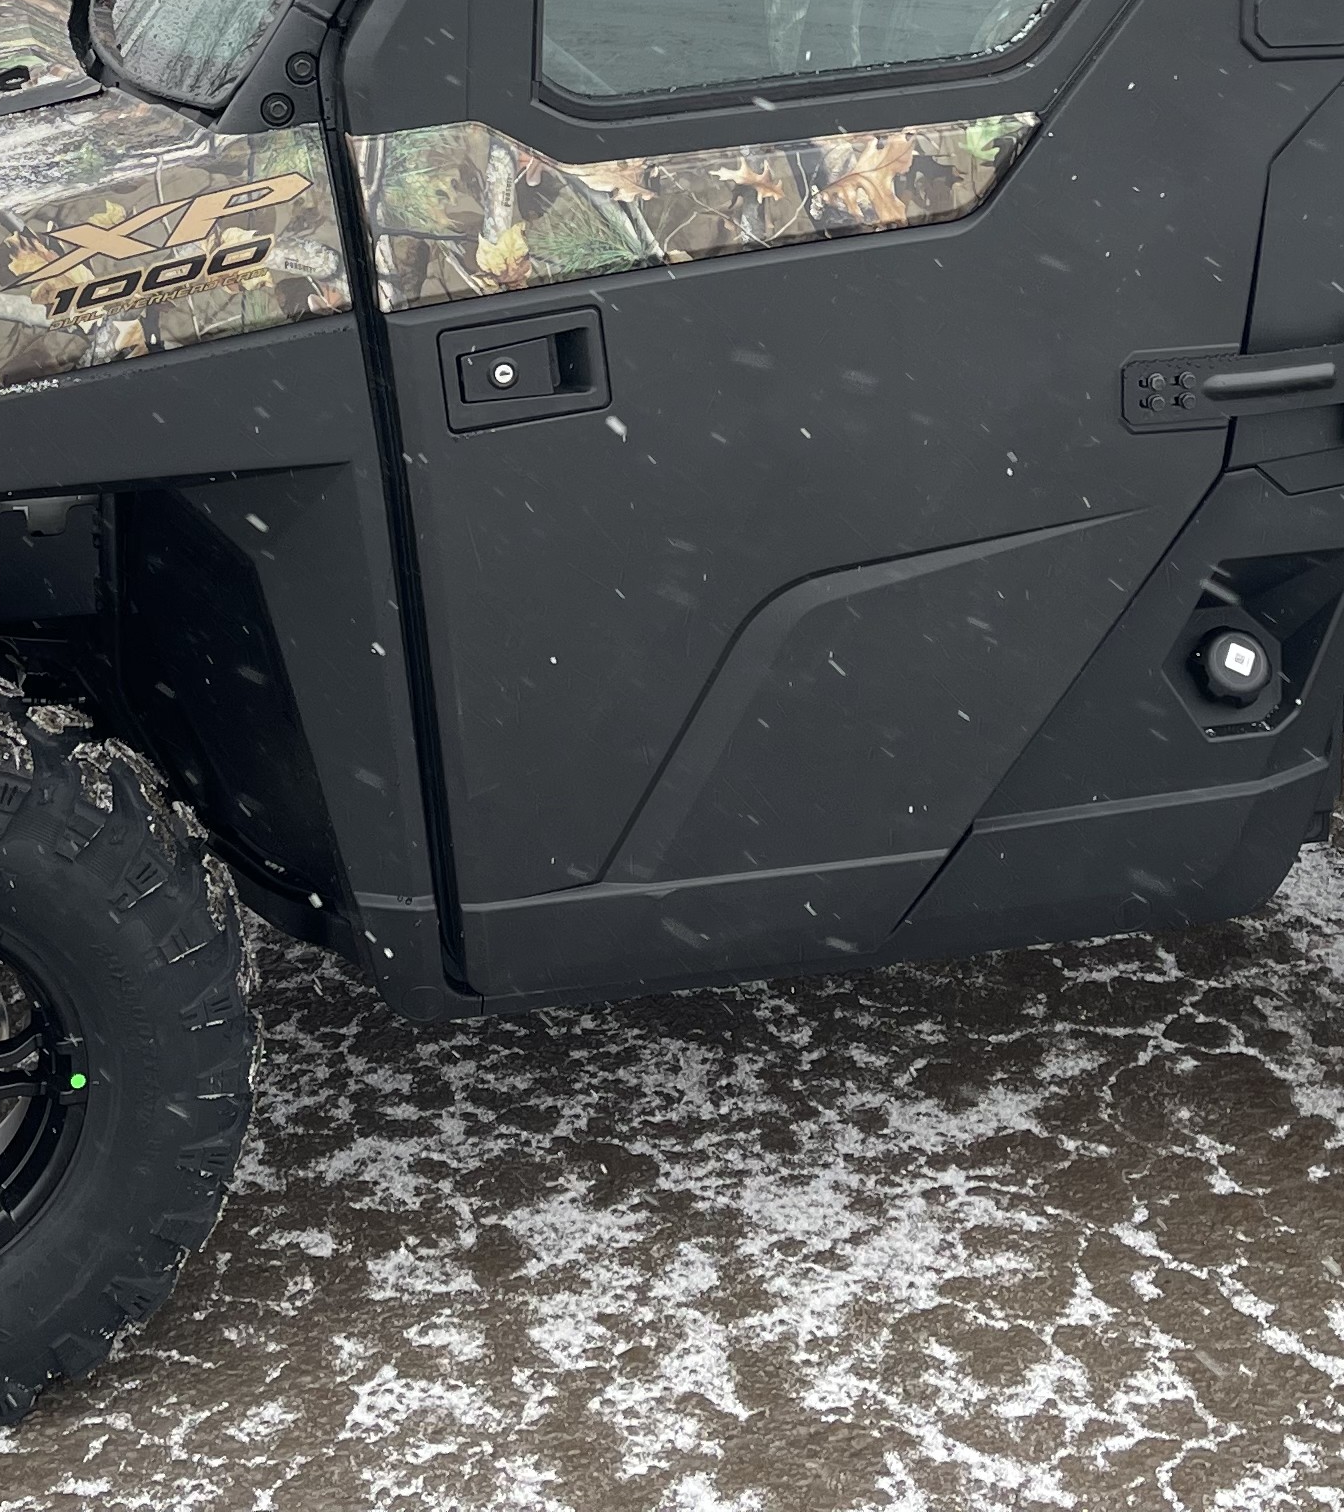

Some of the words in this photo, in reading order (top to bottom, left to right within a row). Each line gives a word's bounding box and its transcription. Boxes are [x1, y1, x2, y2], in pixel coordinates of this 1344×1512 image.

[1, 171, 313, 292] XP
[49, 235, 274, 318] 1000
[49, 310, 103, 330] DUAL
[106, 281, 220, 316] OVERHEAD
[221, 268, 268, 287] CAM
